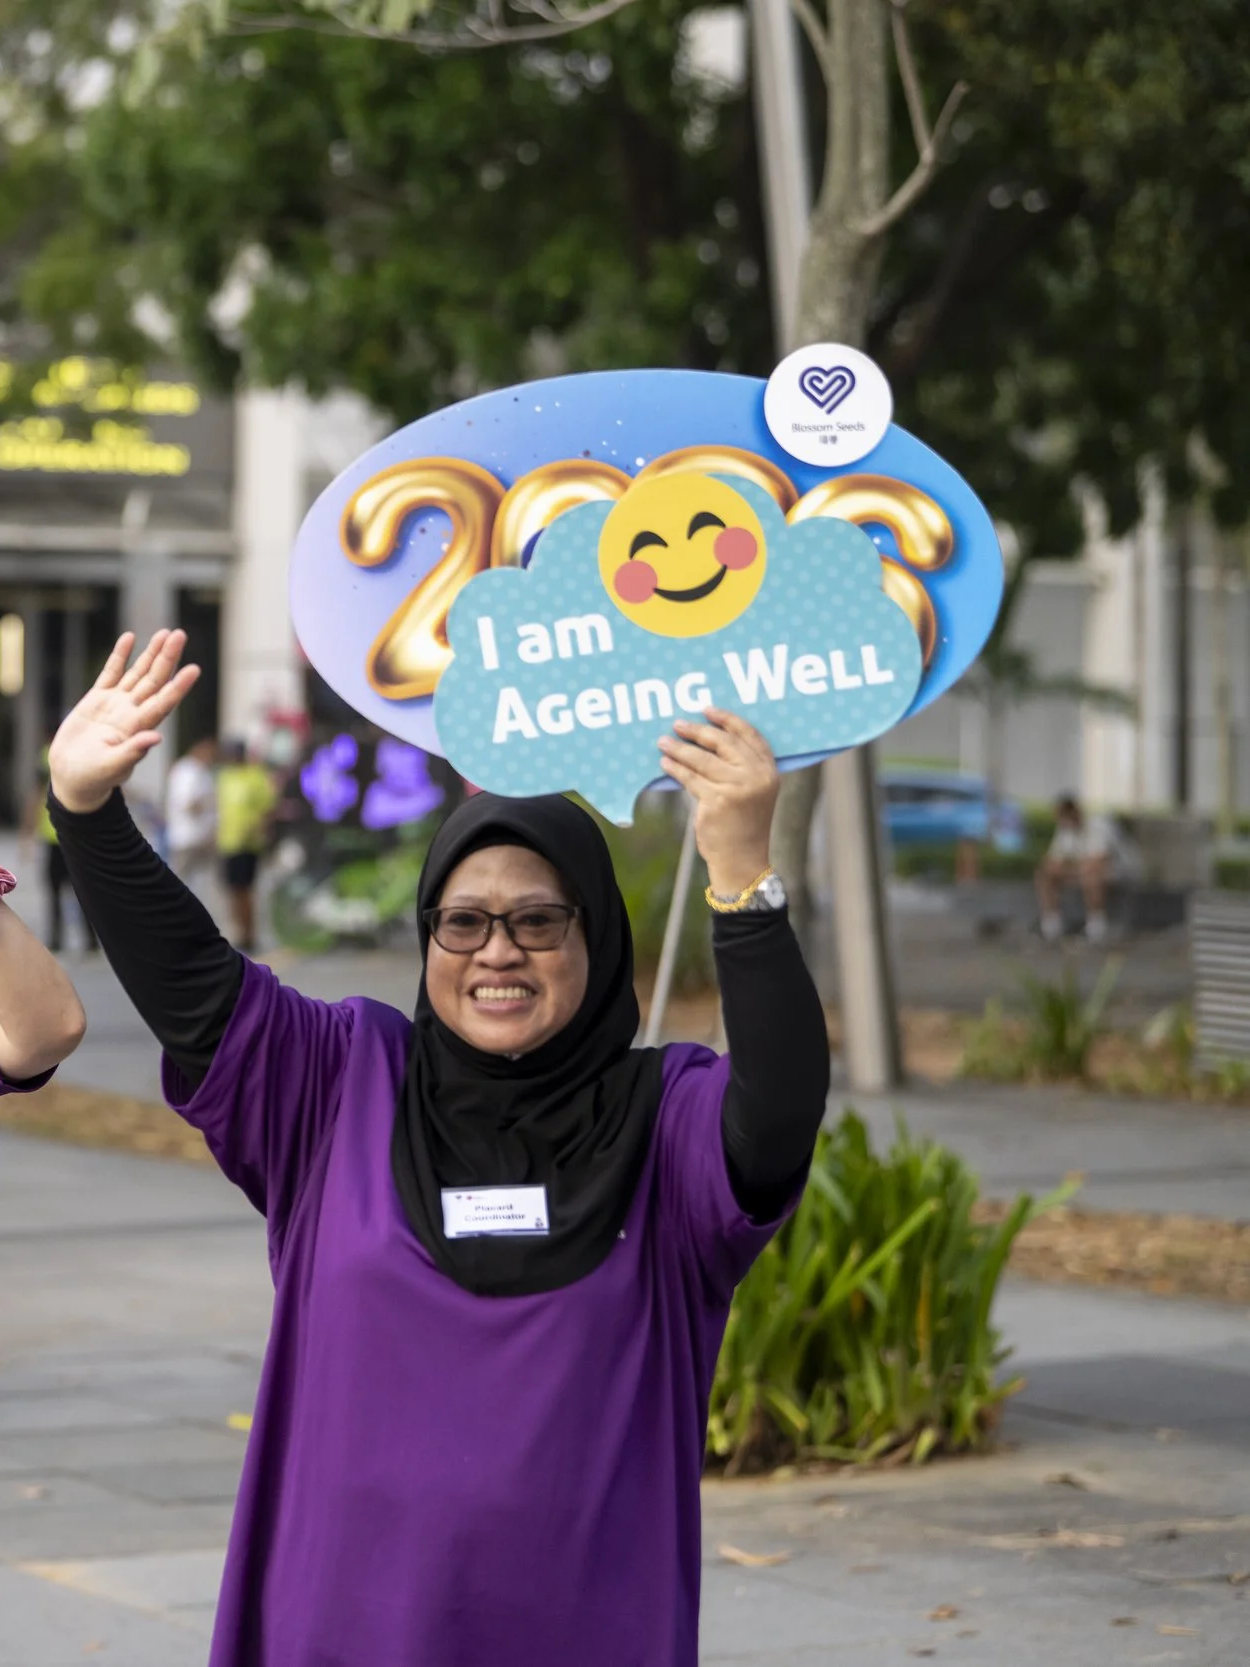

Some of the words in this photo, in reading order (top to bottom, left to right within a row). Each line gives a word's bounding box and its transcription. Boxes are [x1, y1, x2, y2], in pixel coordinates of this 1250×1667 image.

[791, 422, 833, 433] Blossom
[836, 421, 865, 432] Seeds
[476, 616, 499, 670] I
[515, 613, 615, 665] am
